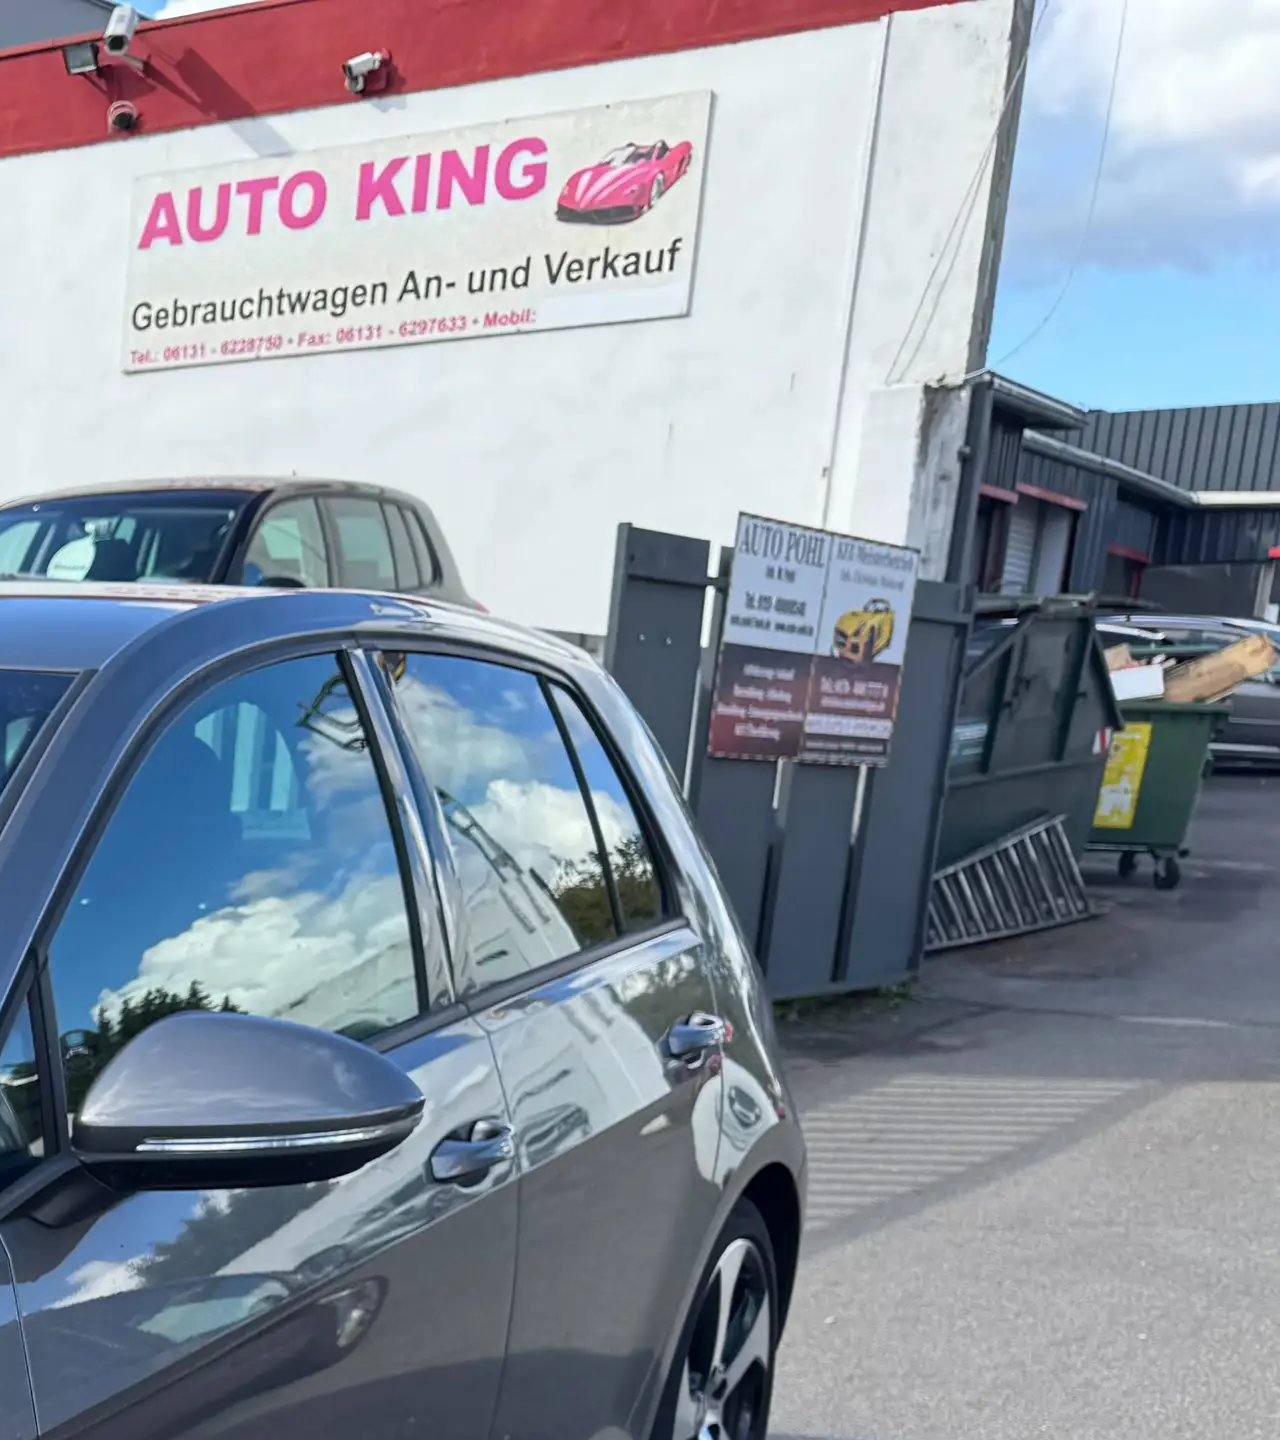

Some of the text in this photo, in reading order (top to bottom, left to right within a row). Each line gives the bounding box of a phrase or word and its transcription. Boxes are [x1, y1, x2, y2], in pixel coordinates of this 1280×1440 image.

[137, 136, 548, 250] AUTO KING
[131, 238, 683, 332] Gebrauchtwagen An- und Verkauf
[163, 341, 206, 361] 06131
[297, 331, 331, 347] Fax:
[336, 324, 383, 343] 06131
[398, 315, 467, 338] 6297633
[483, 308, 537, 329] Mobil:
[739, 522, 826, 569] AUTO POHL
